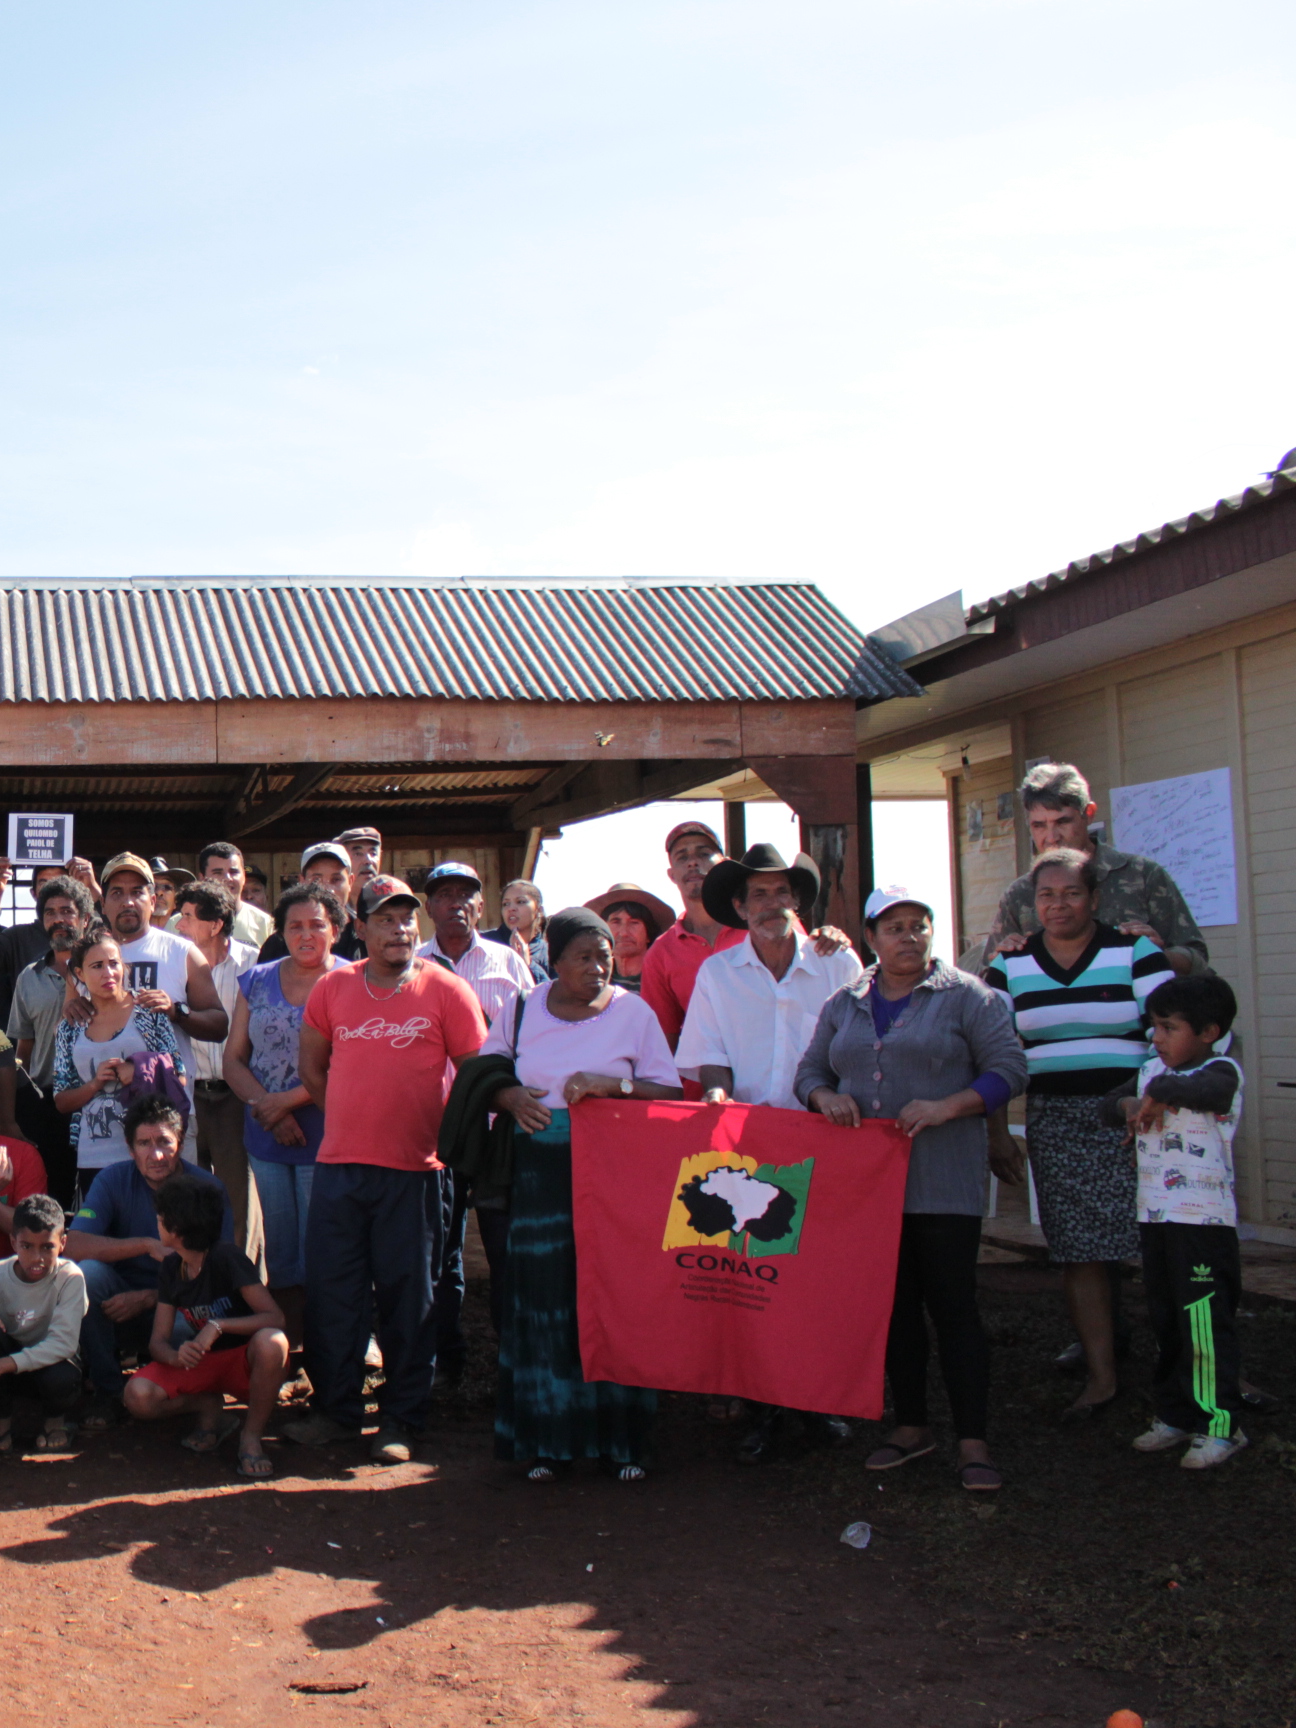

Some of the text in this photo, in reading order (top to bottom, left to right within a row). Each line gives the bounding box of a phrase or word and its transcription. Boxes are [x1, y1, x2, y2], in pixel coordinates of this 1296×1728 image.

[28, 819, 54, 828] SOMOS
[24, 829, 58, 838] QUILOMBO
[26, 839, 55, 848] PAIOL DE
[28, 849, 52, 859] TELHA
[675, 1252, 779, 1285] CONAQ
